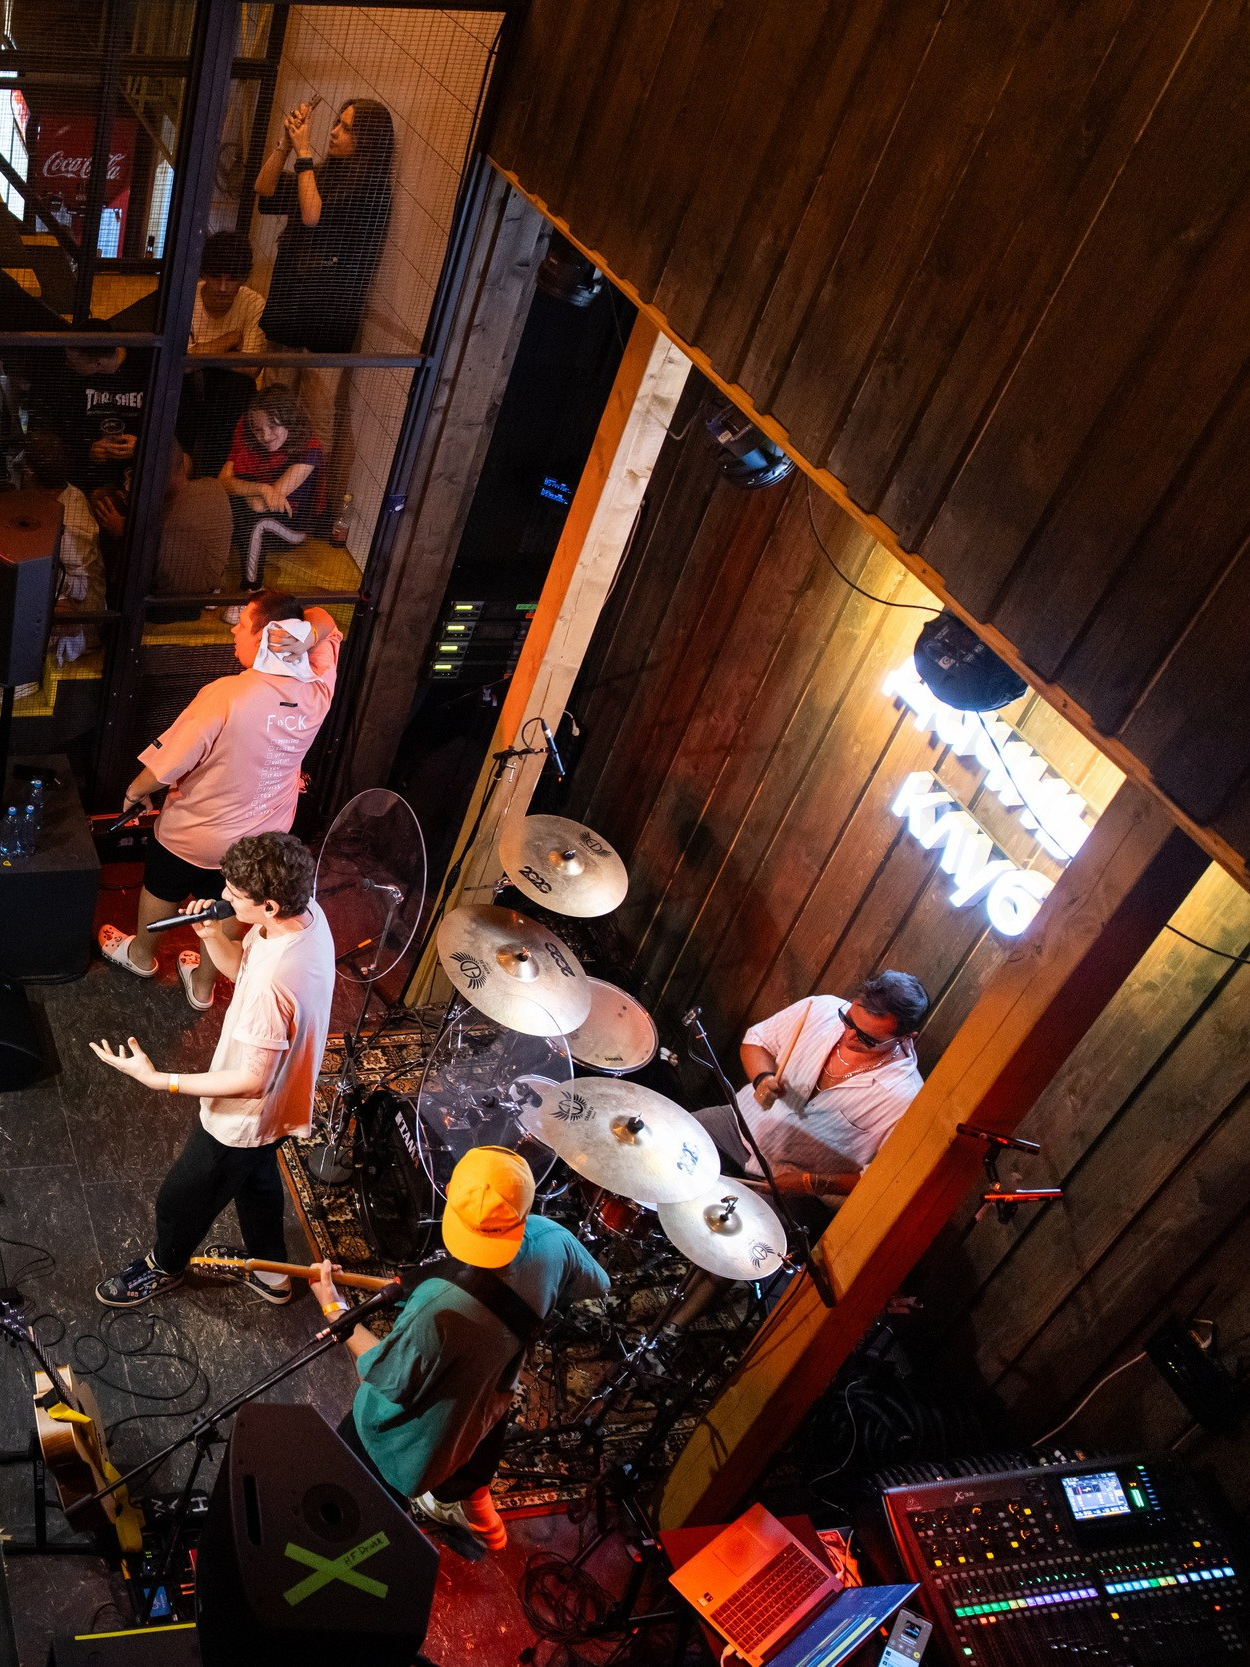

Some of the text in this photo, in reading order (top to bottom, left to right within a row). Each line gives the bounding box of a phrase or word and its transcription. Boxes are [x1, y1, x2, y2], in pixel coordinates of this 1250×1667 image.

[42, 150, 128, 180] Coca-Cla
[518, 865, 553, 894] 2020
[544, 941, 576, 978] 2020
